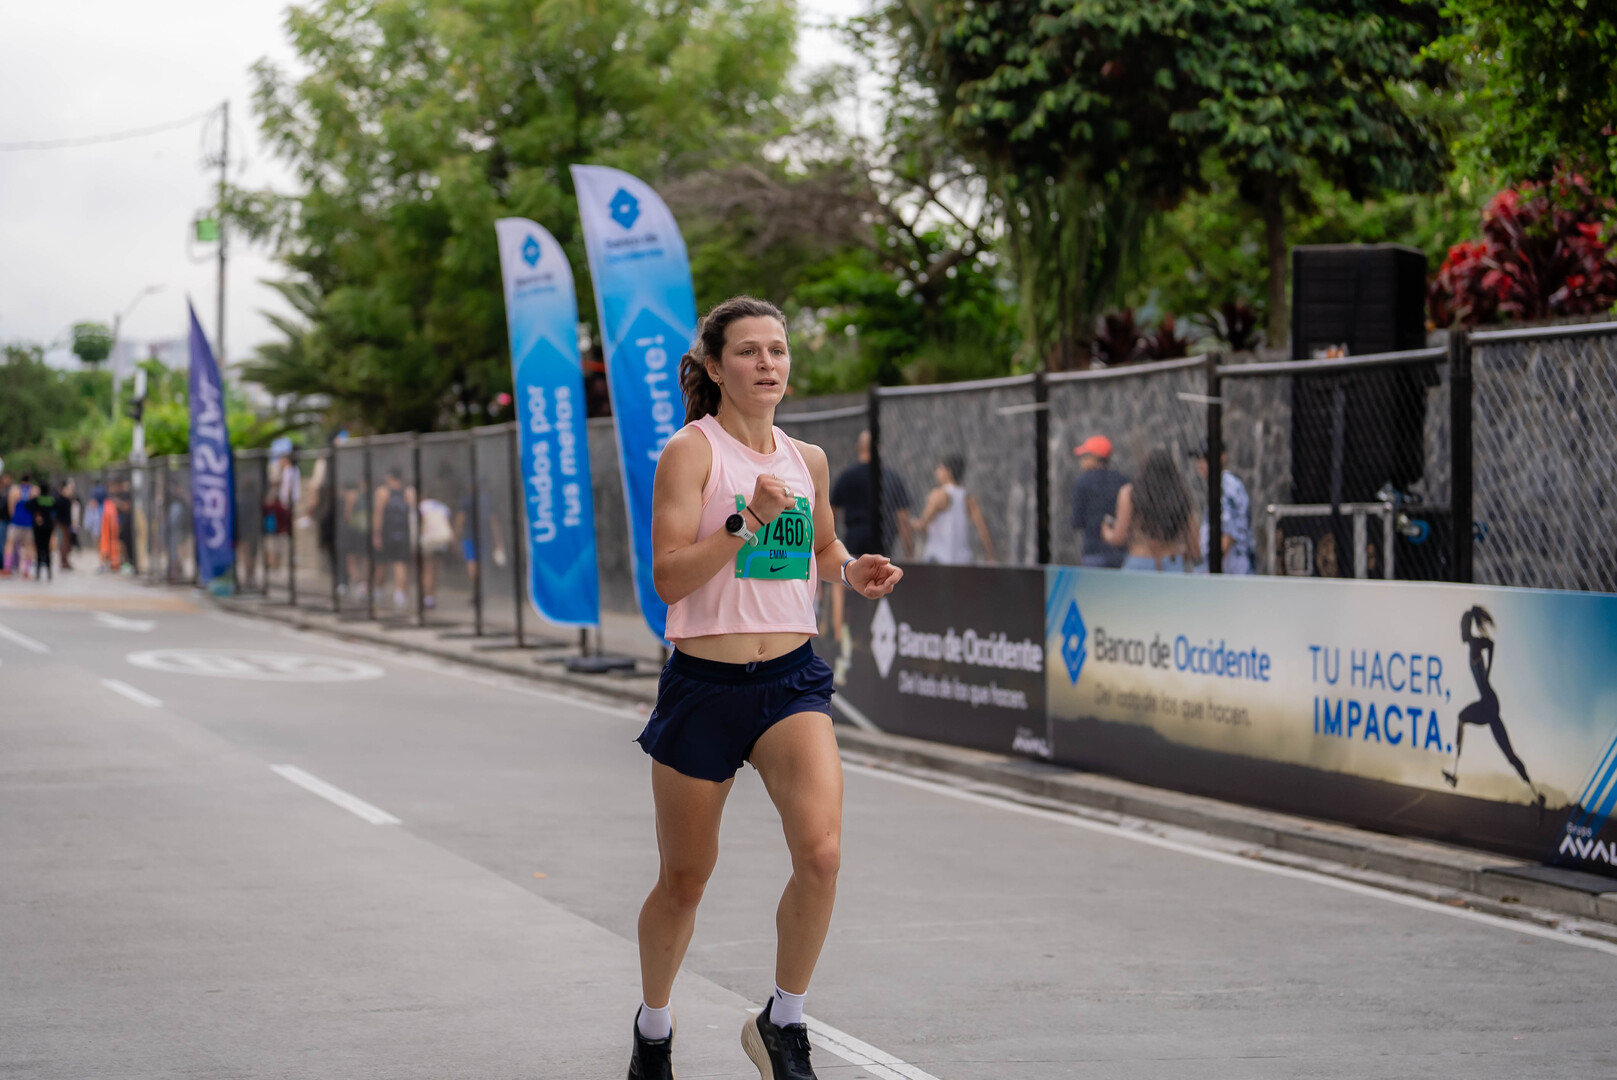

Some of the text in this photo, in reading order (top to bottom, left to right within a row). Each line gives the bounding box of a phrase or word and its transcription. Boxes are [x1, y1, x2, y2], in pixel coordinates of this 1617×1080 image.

[527, 385, 556, 543] Unidos por
[553, 385, 582, 527] tus metas
[769, 549, 788, 560] EMMA
[899, 622, 1043, 673] Banco de Occidente
[1094, 627, 1271, 682] Banco de Occidente
[1308, 644, 1451, 704] TU HACER,
[1314, 695, 1452, 754] IMPACTA.
[1559, 833, 1617, 867] AVAL
